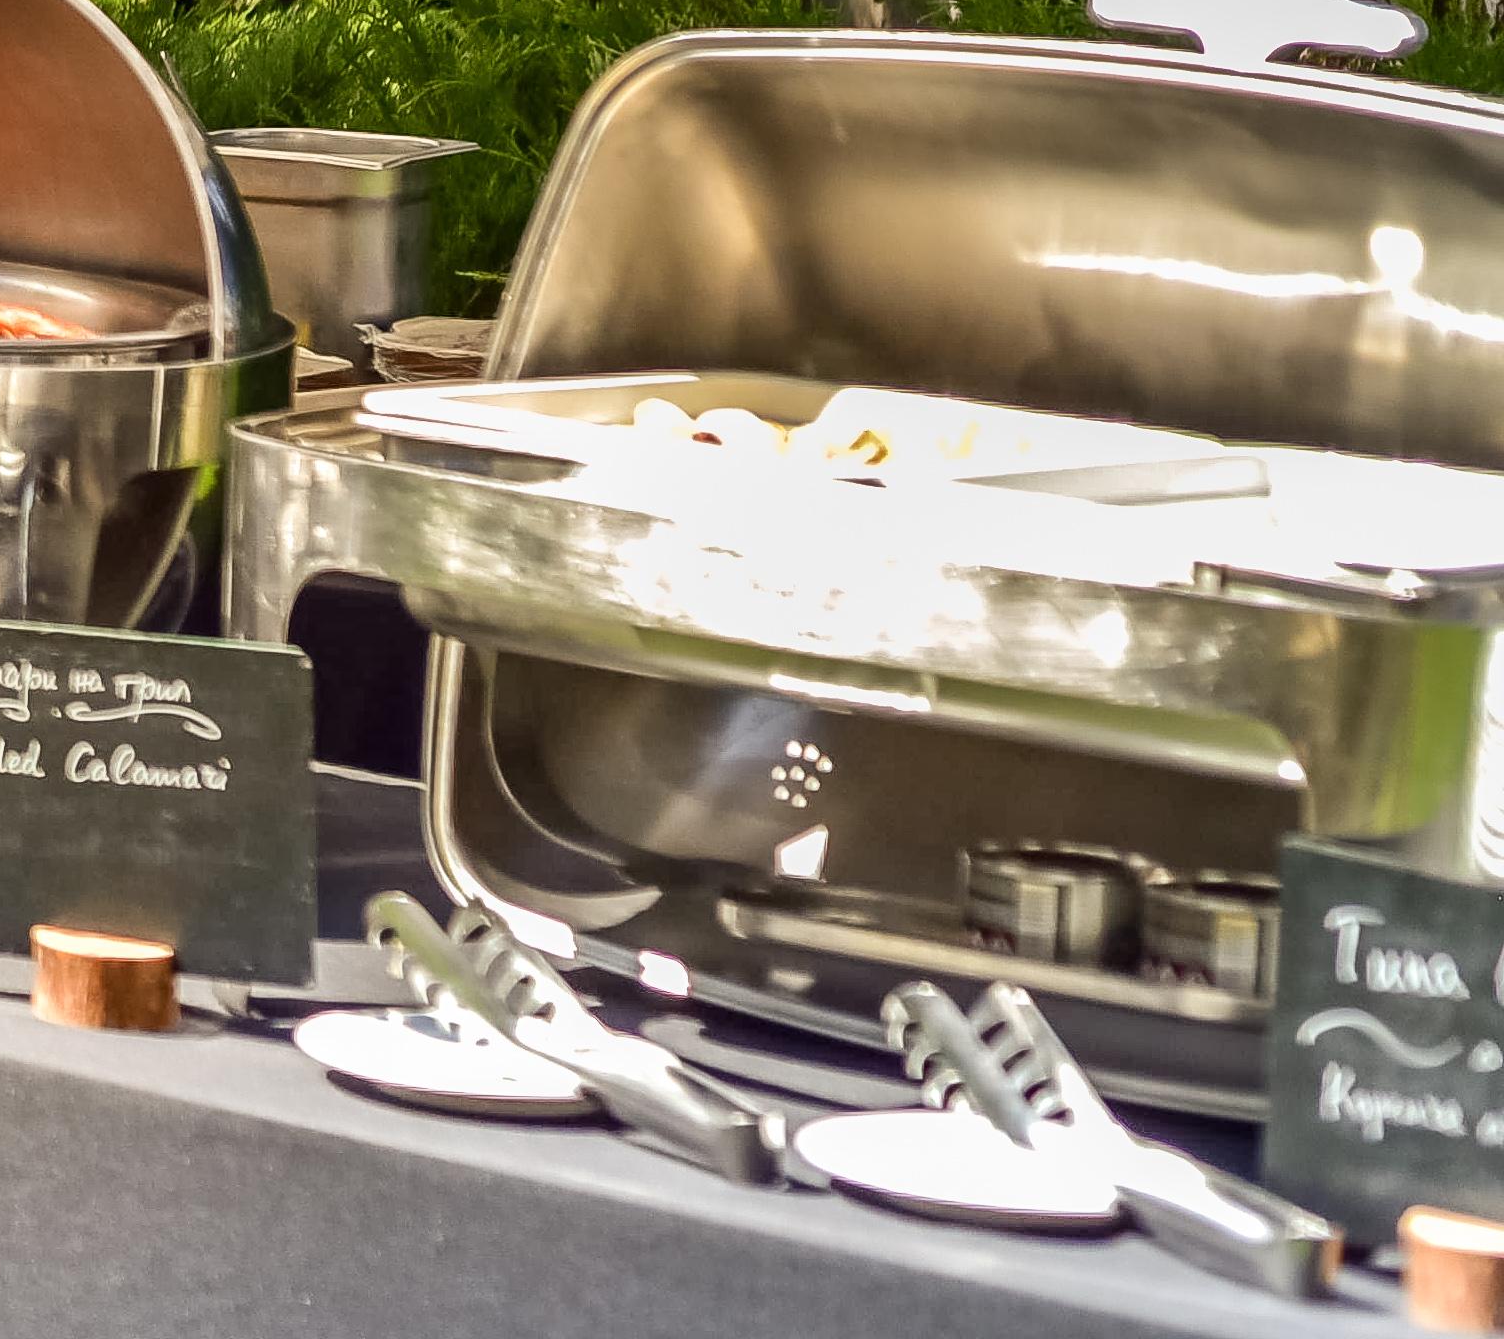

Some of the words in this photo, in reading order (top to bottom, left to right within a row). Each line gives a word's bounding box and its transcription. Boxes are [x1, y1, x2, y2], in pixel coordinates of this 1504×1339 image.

[68, 668, 106, 695] на
[63, 740, 233, 793] Calamari
[1321, 902, 1472, 1003] Tuna
